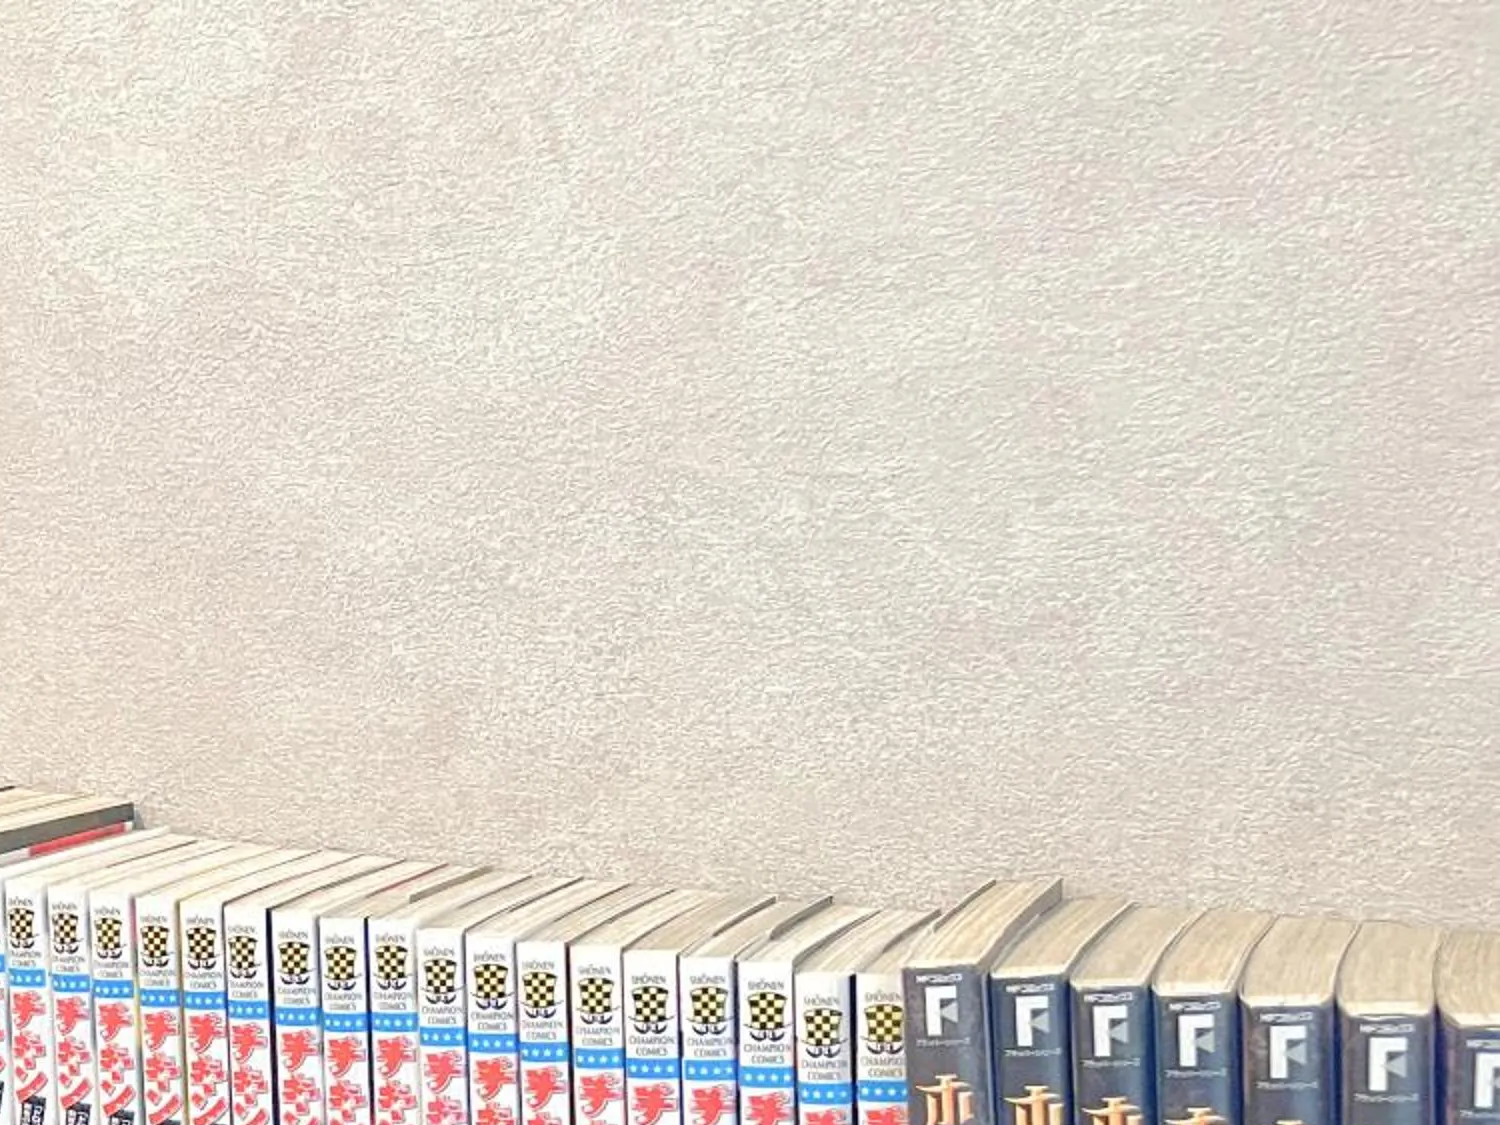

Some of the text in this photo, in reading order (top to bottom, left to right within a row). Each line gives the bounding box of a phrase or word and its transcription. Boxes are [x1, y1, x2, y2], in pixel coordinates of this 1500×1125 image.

[12, 990, 48, 1102] チキン
[54, 995, 92, 1110] チキン
[98, 1001, 136, 1117] チキン
